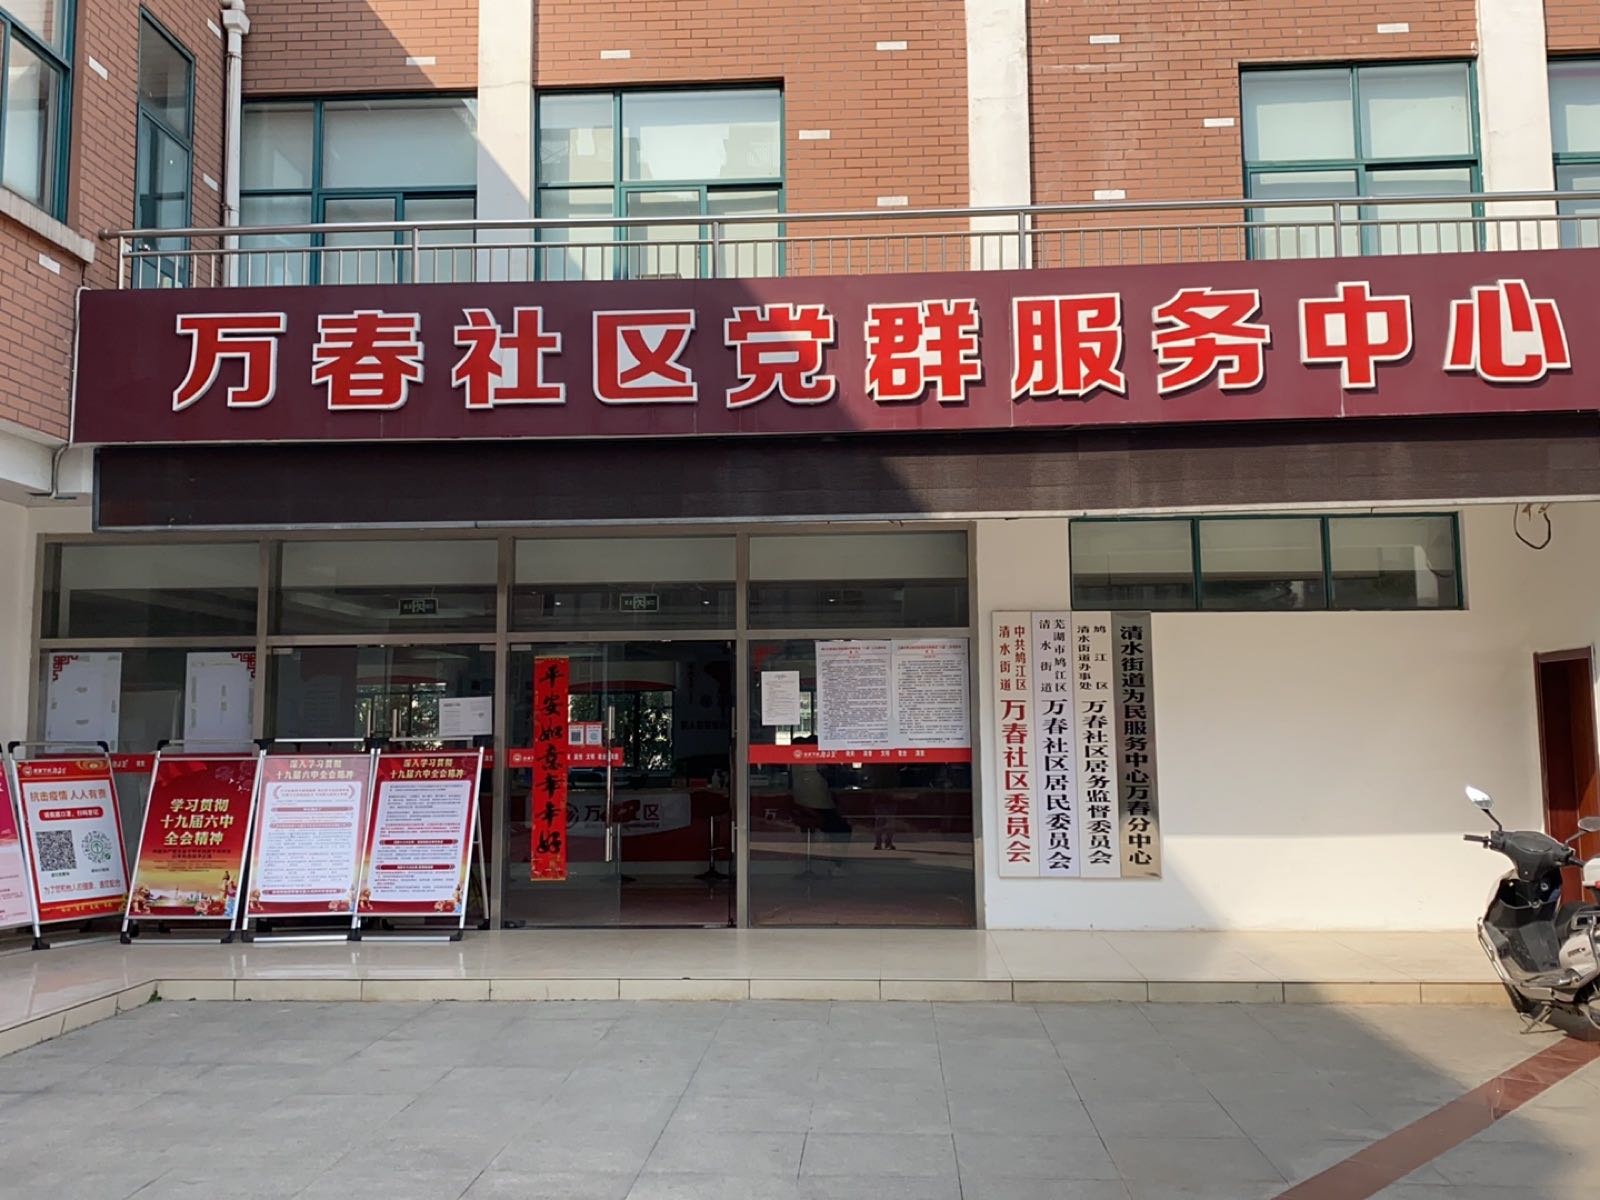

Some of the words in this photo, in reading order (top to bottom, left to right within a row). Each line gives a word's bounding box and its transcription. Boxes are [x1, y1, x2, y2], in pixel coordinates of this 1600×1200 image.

[171, 278, 1572, 412] 万春社区党群服务中心
[999, 625, 1011, 691] 清水街道
[1014, 625, 1027, 690] 中共鸠江区
[1039, 619, 1052, 692] 清水街道
[1053, 619, 1067, 692] 芜湖市鸠江区
[1077, 625, 1091, 690] 清水街道办事处
[1094, 625, 1108, 690] 鸠江区
[1120, 625, 1153, 865] 清水街道为民服务中心万春分中心
[170, 798, 229, 812] 学习贯彻
[1000, 699, 1031, 863] 万春社区委员会
[1041, 699, 1072, 869] 万春社区居民委员会
[1082, 700, 1113, 864] 万春社区居务监督委员会
[160, 814, 234, 829] 十九届六中
[163, 831, 224, 846] 全会精神
